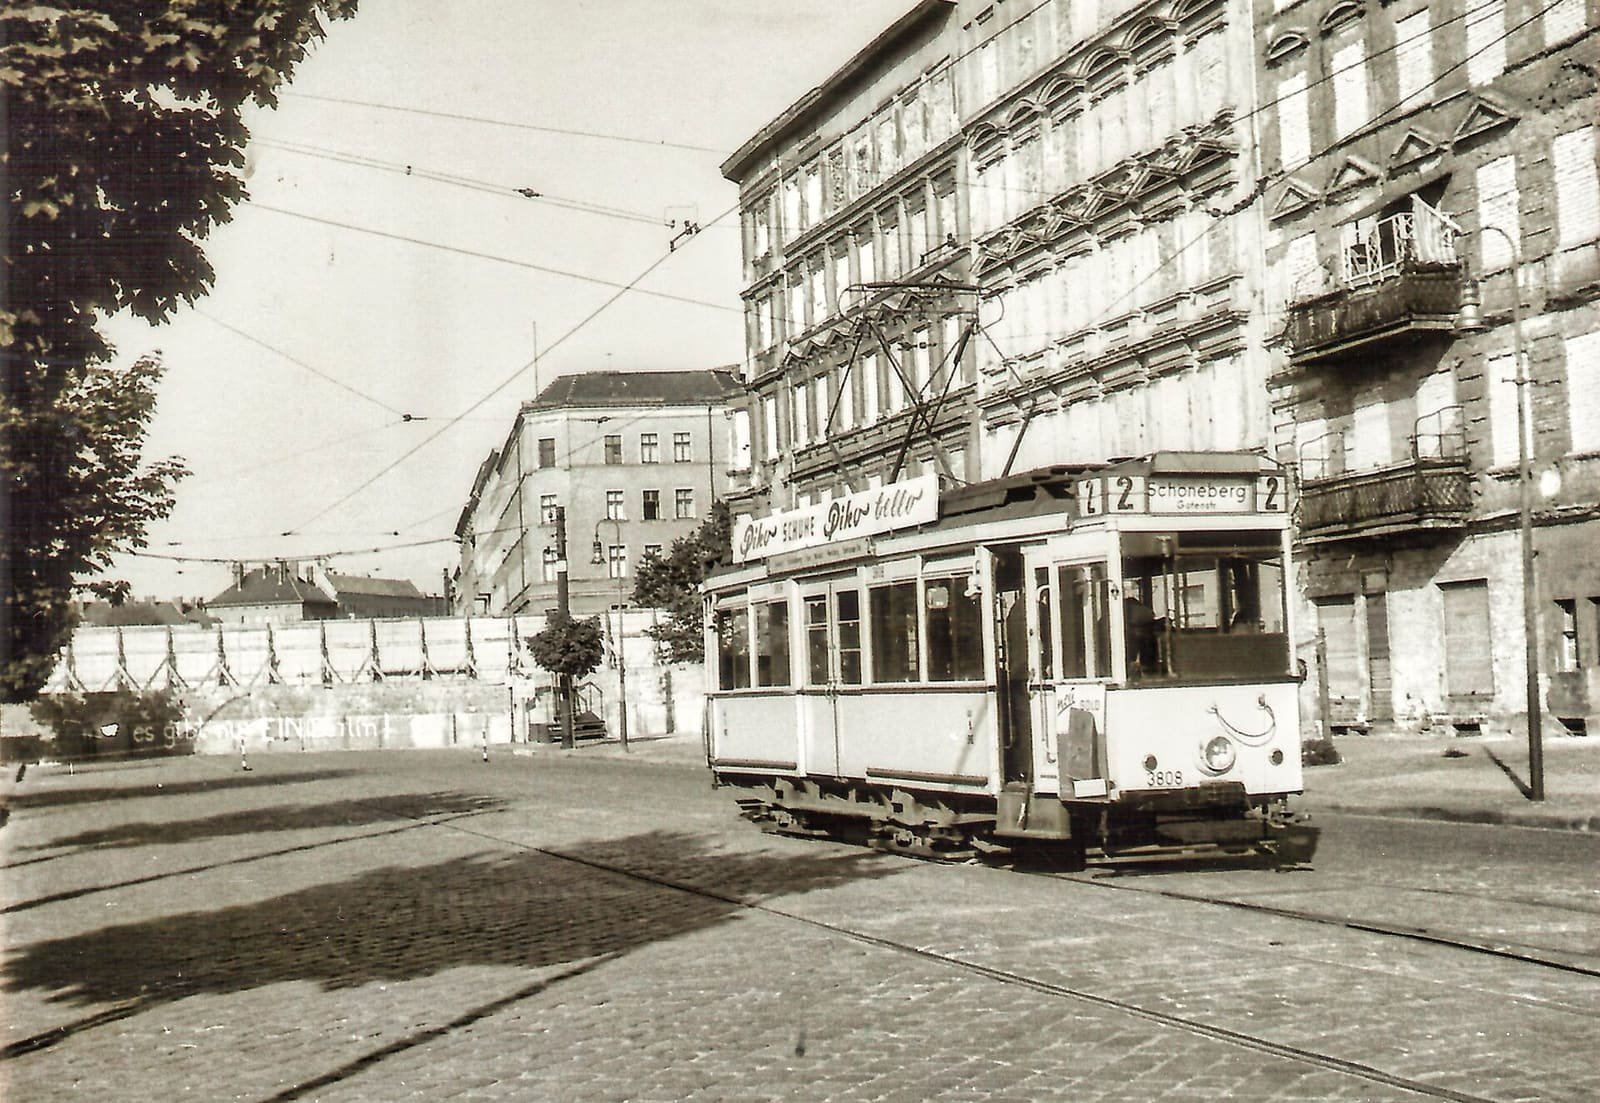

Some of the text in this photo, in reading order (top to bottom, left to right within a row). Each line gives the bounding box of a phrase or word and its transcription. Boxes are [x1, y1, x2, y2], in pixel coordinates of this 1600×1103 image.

[1117, 476, 1133, 510] 2
[1265, 477, 1279, 510] 2
[782, 516, 814, 542] SCHUHE
[823, 498, 870, 541] Piko
[133, 726, 156, 743] es
[262, 715, 304, 742] EIN
[1147, 770, 1183, 787] 3808
